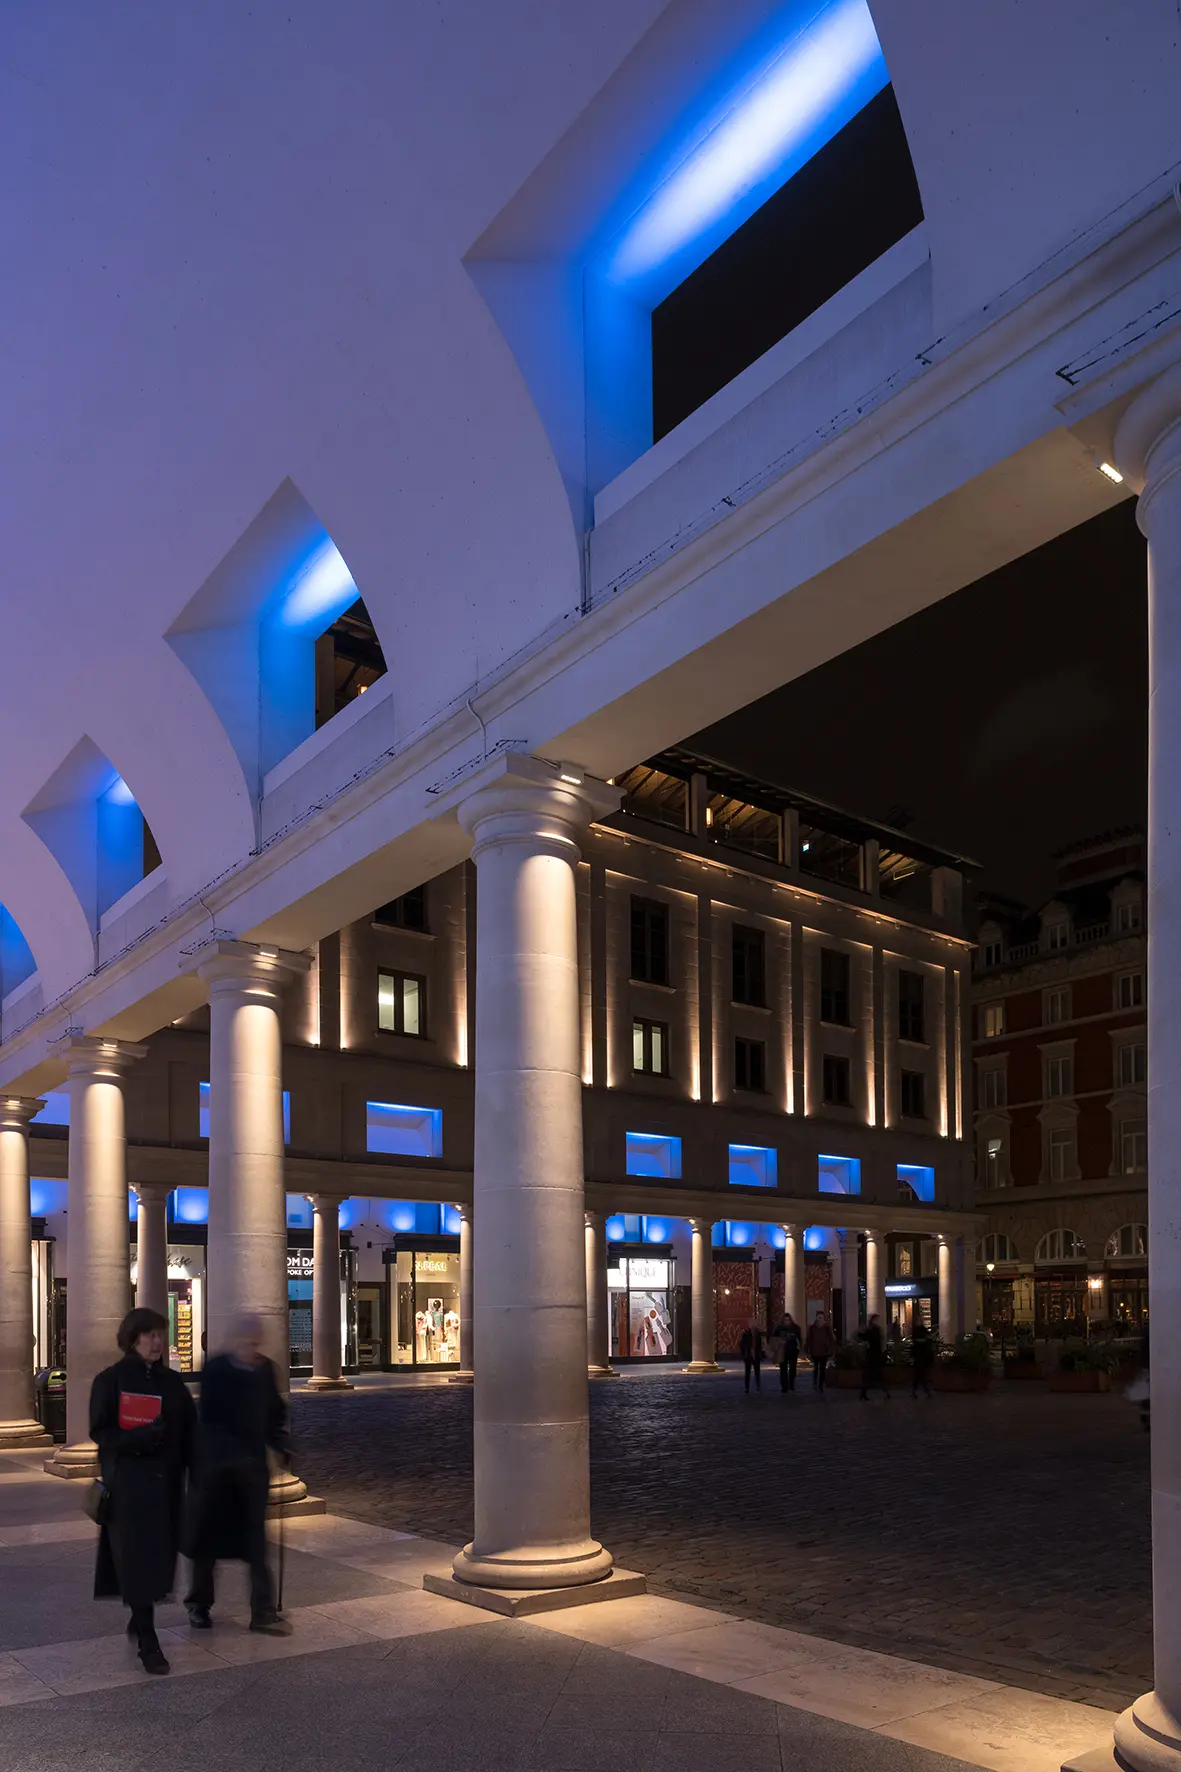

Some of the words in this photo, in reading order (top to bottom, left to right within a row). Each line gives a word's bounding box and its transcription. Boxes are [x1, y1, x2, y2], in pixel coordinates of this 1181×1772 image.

[287, 1257, 300, 1267] OM
[302, 1257, 314, 1267] DA
[619, 1267, 656, 1279] CINIQUE
